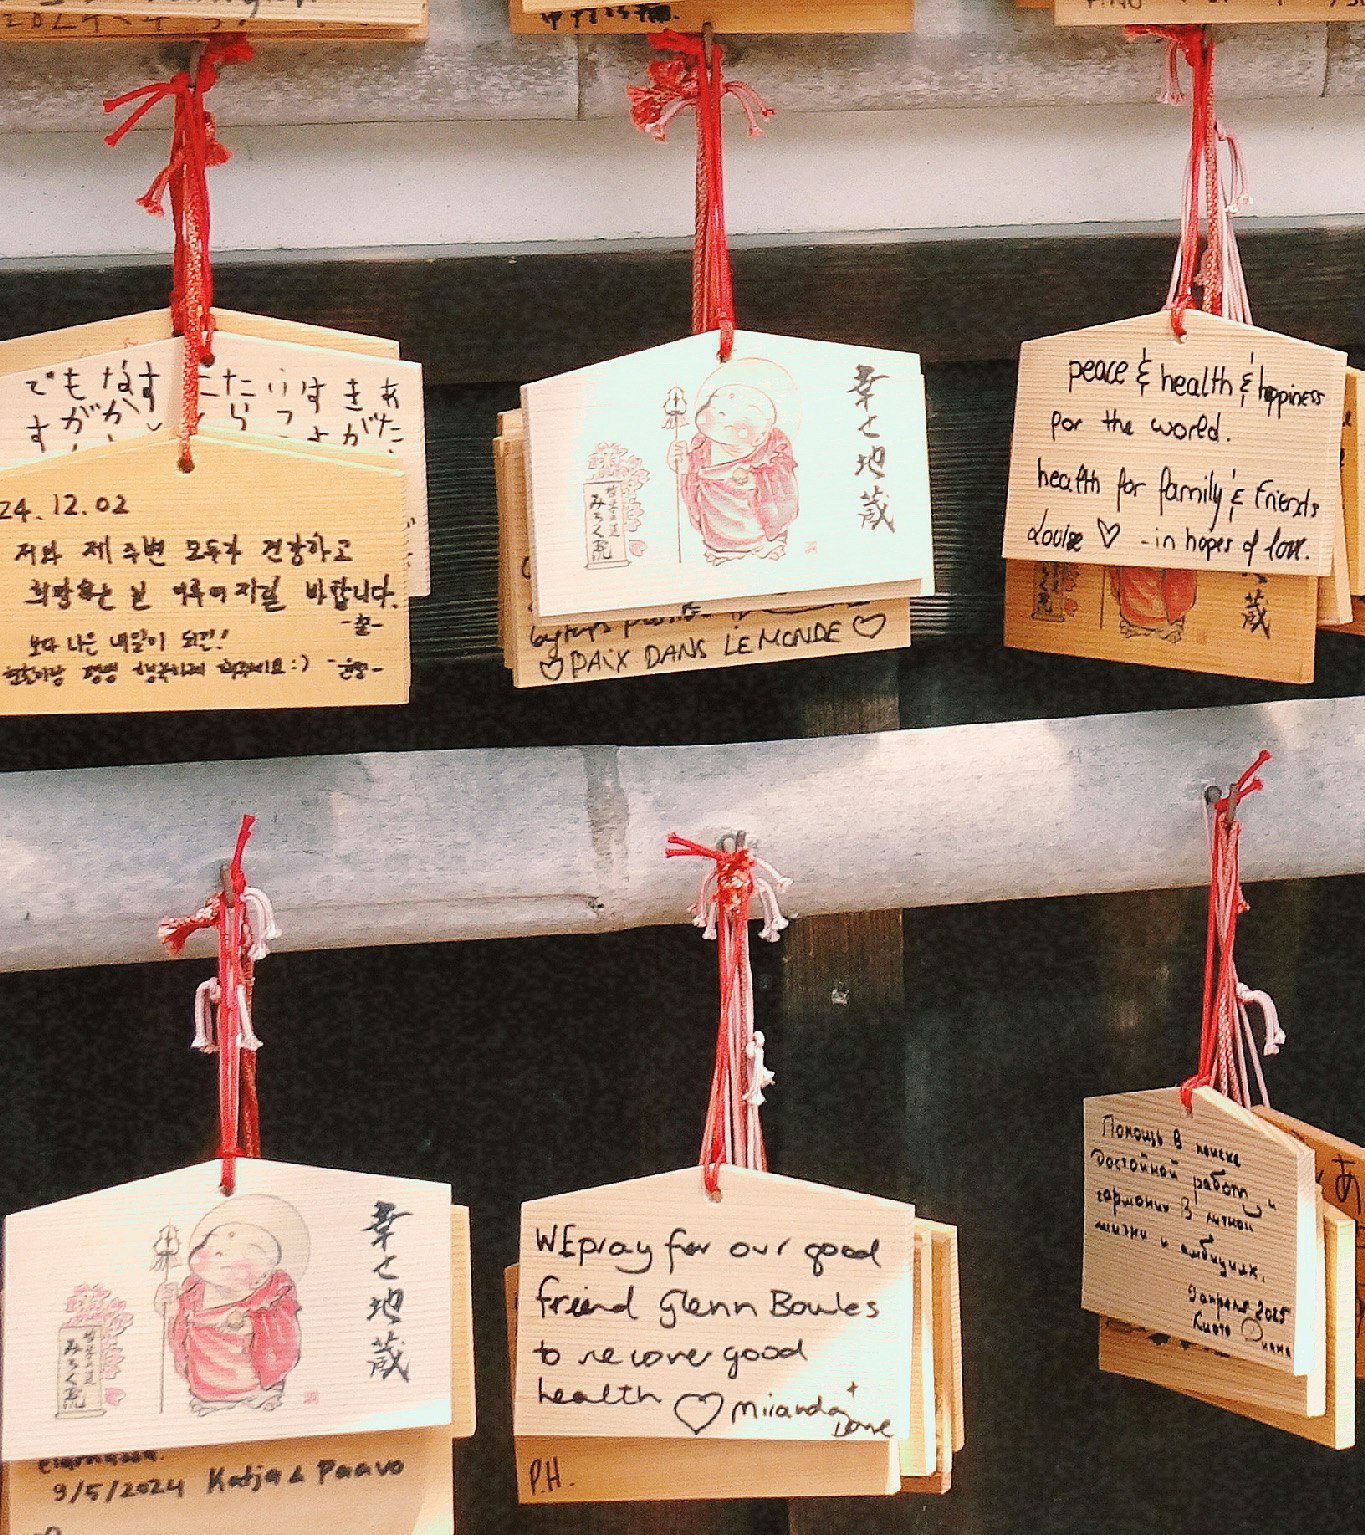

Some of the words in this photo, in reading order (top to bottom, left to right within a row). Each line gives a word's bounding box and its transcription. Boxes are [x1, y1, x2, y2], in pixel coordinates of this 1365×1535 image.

[1068, 359, 1129, 393] peace
[1160, 363, 1234, 398] health
[1101, 408, 1134, 436] the
[1150, 411, 1231, 443] world.
[1037, 457, 1101, 495] health
[1116, 466, 1147, 513] for
[1158, 465, 1223, 533] family
[261, 531, 353, 567] 건강하고
[1185, 527, 1234, 562] hopes
[644, 636, 708, 670] DANS
[664, 1227, 711, 1275] for
[729, 1238, 790, 1258] our
[803, 1238, 881, 1277] good
[532, 1340, 561, 1367] to
[722, 1338, 807, 1380] good
[537, 1376, 662, 1405] health
